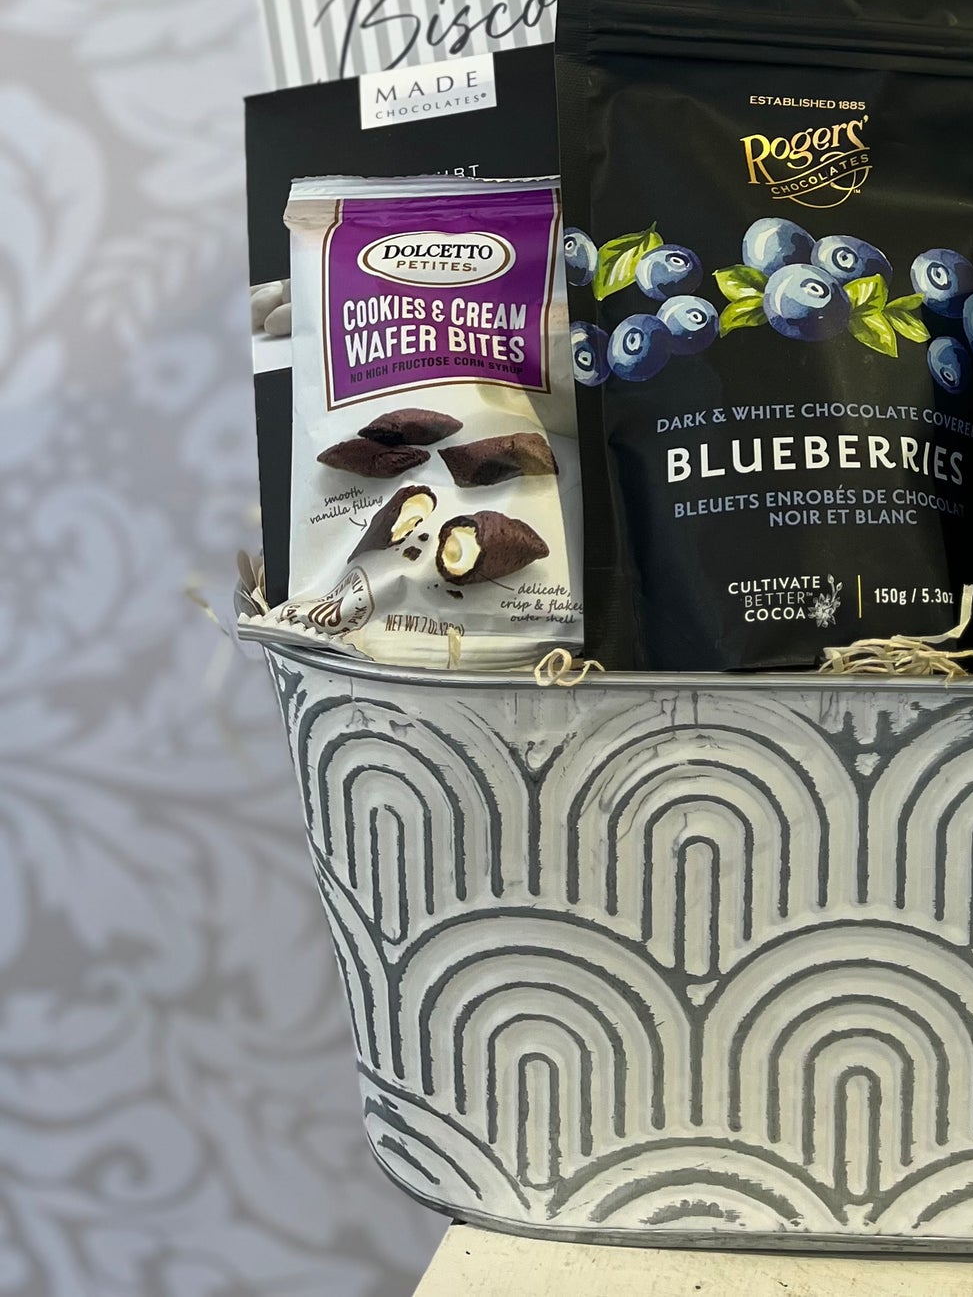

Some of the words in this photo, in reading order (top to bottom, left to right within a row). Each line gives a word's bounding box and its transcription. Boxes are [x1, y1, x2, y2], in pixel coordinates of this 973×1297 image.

[375, 70, 478, 104] MADE
[750, 95, 836, 110] ESTABLISHED
[839, 101, 866, 111] 1885
[771, 153, 870, 195] CHOCOLATES
[382, 244, 493, 260] DOLCETTO
[343, 295, 426, 331] COOKIES
[431, 299, 446, 323] &
[450, 297, 527, 330] CREAM
[344, 324, 437, 368] WAFER
[447, 325, 525, 364] BITES
[350, 371, 364, 383] NO
[366, 365, 388, 380] HIGH
[392, 356, 451, 374] FRUCTOSE
[453, 356, 485, 368] CORN
[488, 362, 524, 376] SYRUP
[656, 410, 707, 433] DARK
[712, 408, 727, 423] &
[732, 404, 796, 421] WHITE
[801, 402, 919, 421] CHOCOLATE
[667, 434, 964, 485] BLUEBERRIES
[324, 486, 364, 507] smooth
[674, 493, 759, 518] BLEUETS
[766, 484, 857, 507] ENROBÉS
[862, 489, 887, 504] DE
[310, 505, 351, 524] vanilla
[352, 495, 384, 515] filling
[769, 510, 822, 527] NOIR
[827, 509, 849, 524] ET
[855, 509, 918, 525] BLANC
[517, 582, 571, 597] delicate,
[728, 576, 821, 595] CULTIVATE
[500, 597, 532, 612] crisp
[534, 598, 544, 610] &
[547, 599, 585, 615] flakey
[874, 588, 907, 605] 150g
[922, 588, 954, 605] 5.3oz
[385, 614, 403, 631] NET
[510, 613, 540, 622] outer
[546, 614, 577, 624] shell
[744, 607, 806, 622] COCOA
